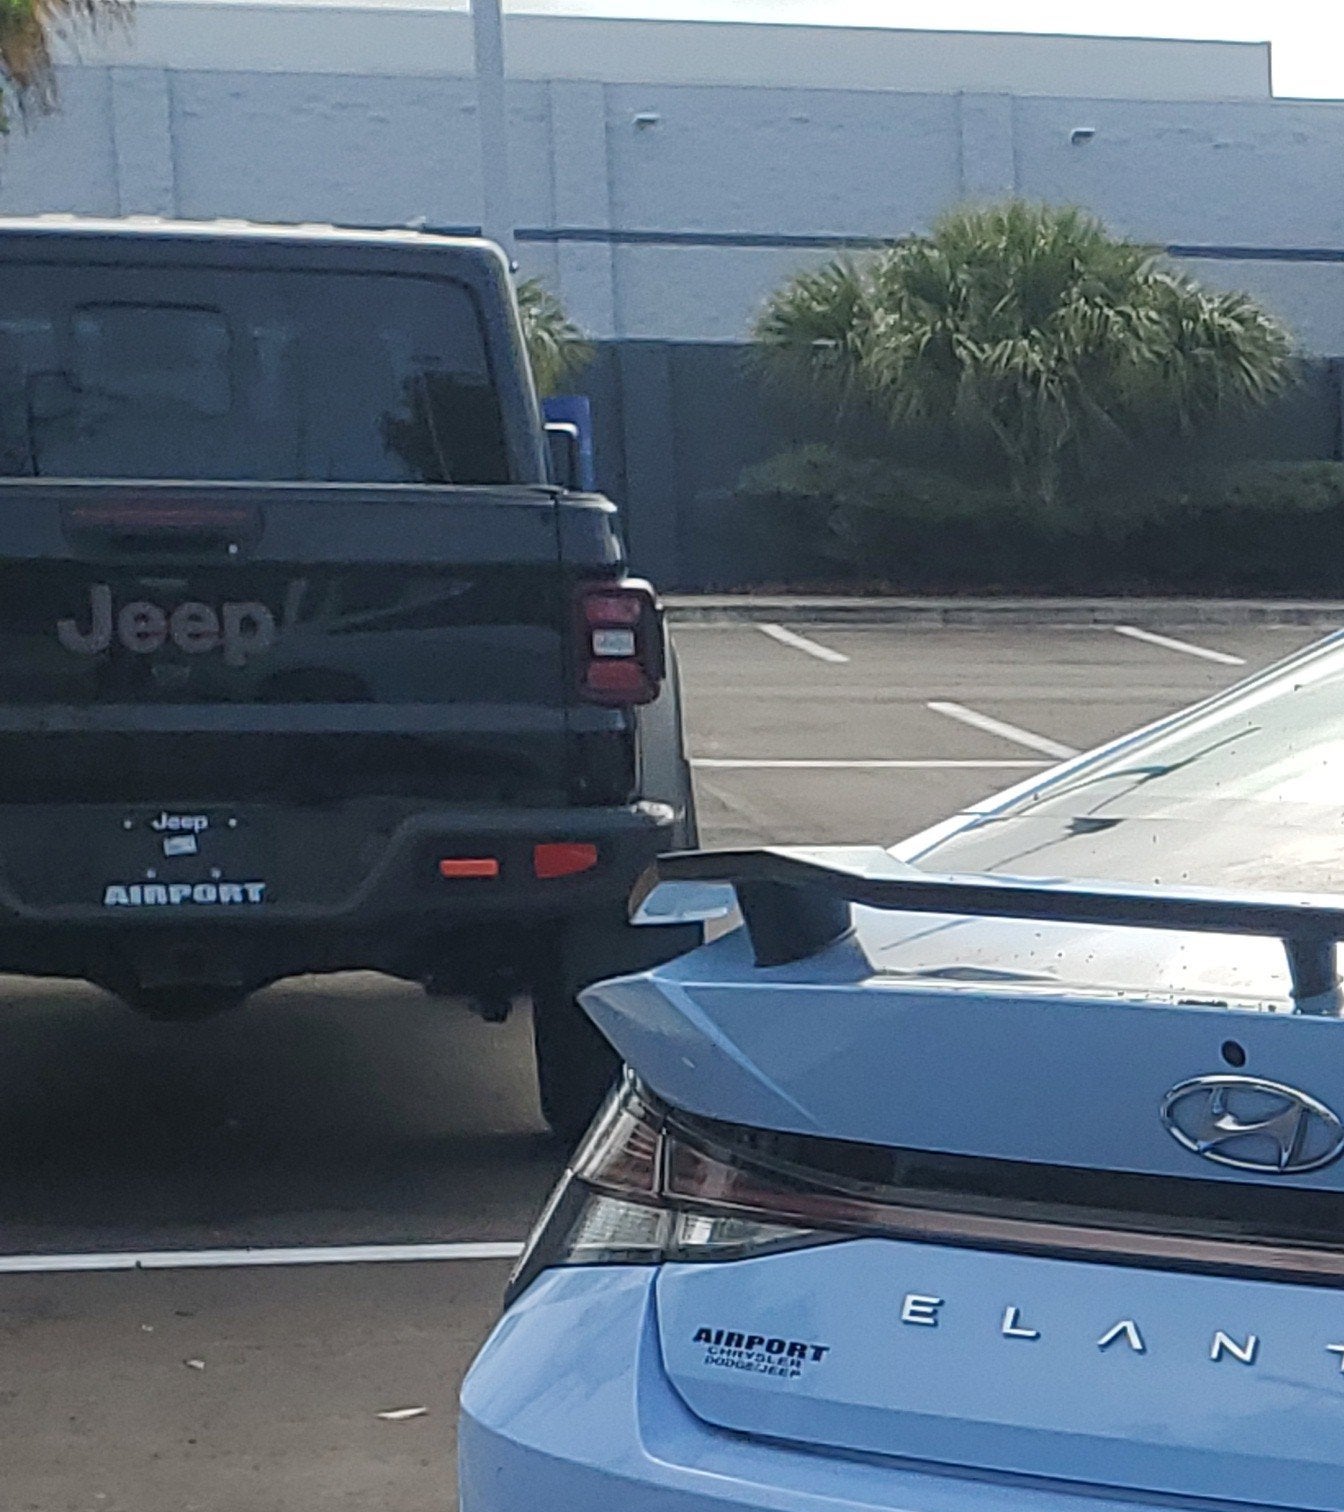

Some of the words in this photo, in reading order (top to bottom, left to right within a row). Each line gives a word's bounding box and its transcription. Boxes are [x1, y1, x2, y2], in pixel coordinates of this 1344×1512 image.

[57, 582, 276, 666] Jeep
[151, 811, 209, 834] Jeep
[103, 882, 267, 906] AIRPORT
[692, 1326, 831, 1363] AIRPORT
[707, 1345, 801, 1369] CHRYSLER
